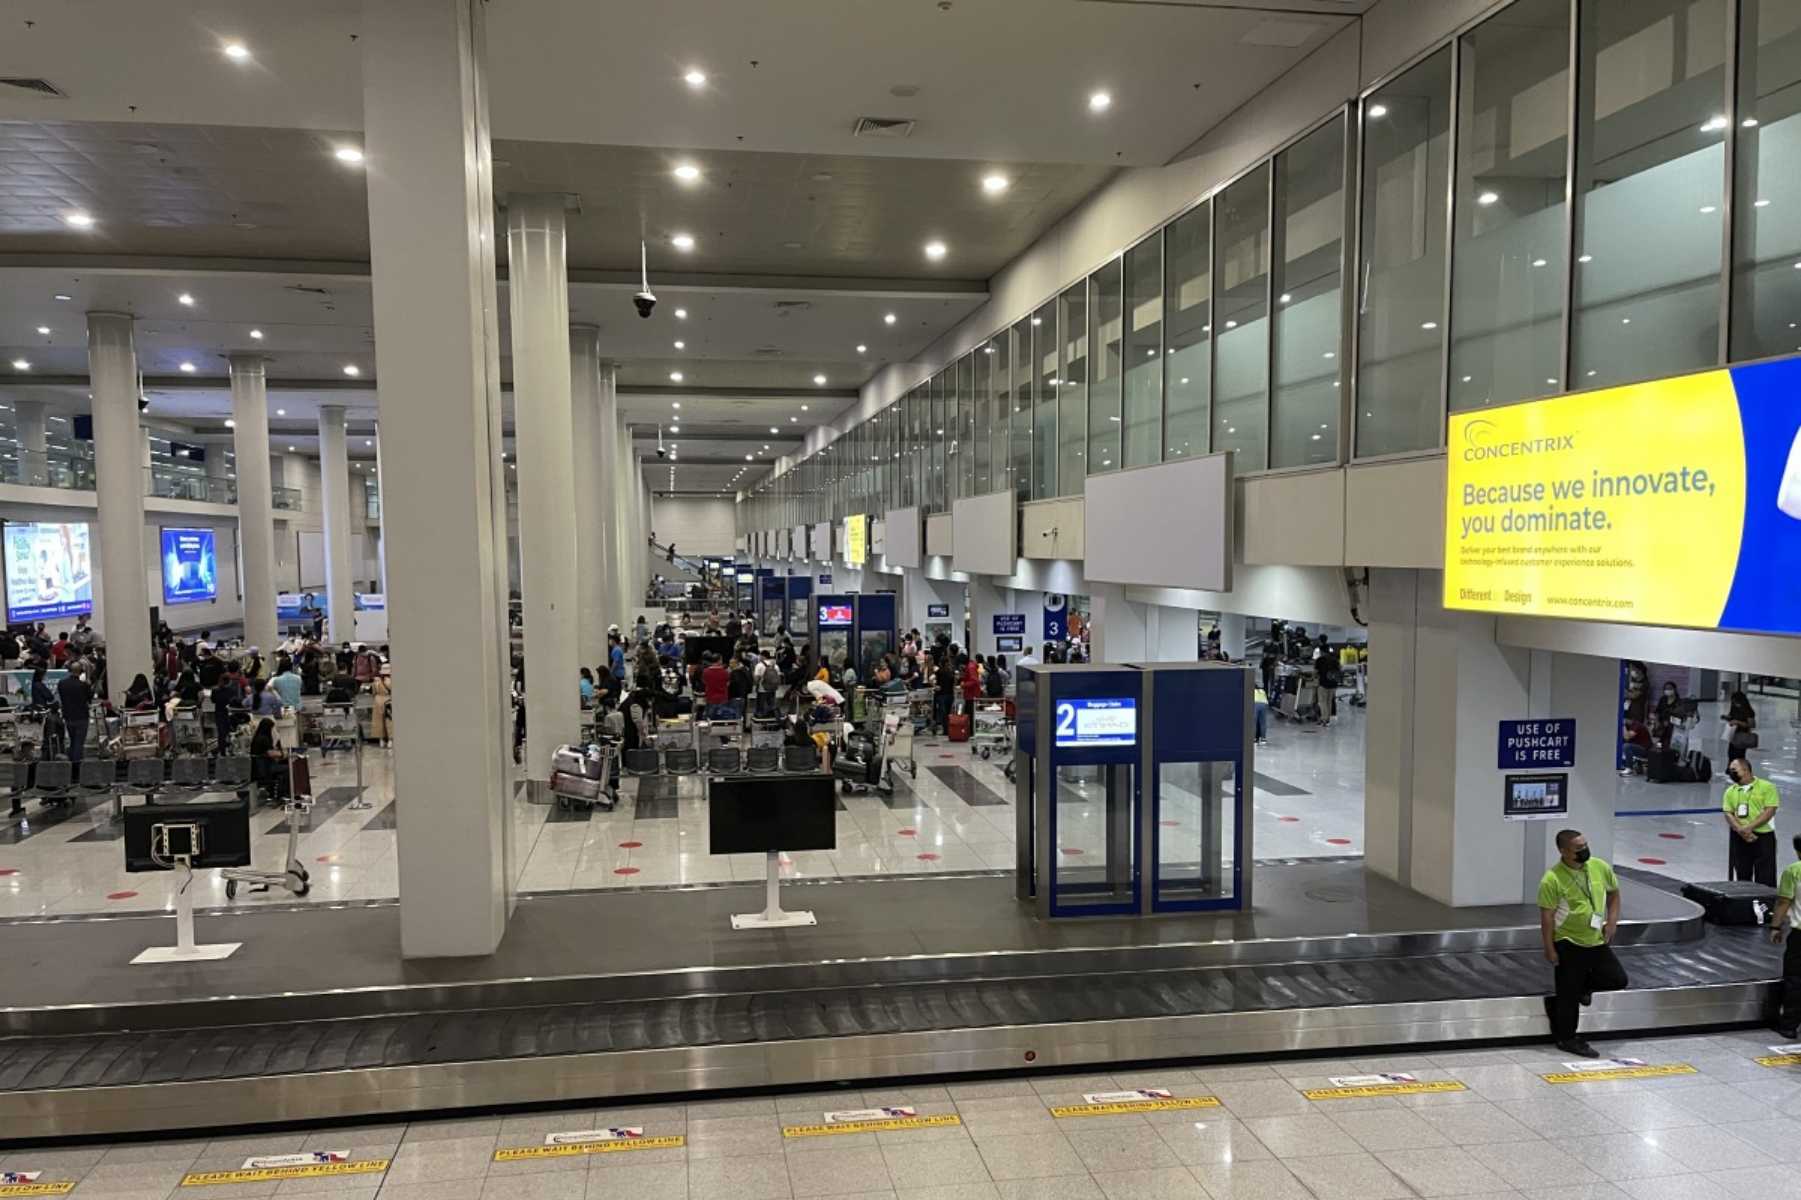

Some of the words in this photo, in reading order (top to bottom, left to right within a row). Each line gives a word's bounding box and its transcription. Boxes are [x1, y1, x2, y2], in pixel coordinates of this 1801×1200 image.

[1463, 435, 1574, 461] CONCENTRIX
[1463, 482, 1545, 506] Because
[1552, 479, 1584, 500] we
[1592, 466, 1716, 498] innovate,
[1461, 514, 1495, 539] you
[1501, 505, 1612, 532] dominate.
[1570, 545, 1587, 554] with
[1589, 546, 1602, 554] our
[1460, 588, 1492, 601] Different
[1504, 590, 1532, 606] Design
[820, 606, 828, 620] 3
[1049, 621, 1059, 635] 3
[1056, 703, 1075, 736] 2
[1516, 724, 1539, 735] USE
[1545, 723, 1561, 734] OF
[1507, 736, 1569, 748] PUSHCART
[1515, 750, 1527, 761] IS
[1533, 749, 1561, 760] FREE
[499, 1148, 539, 1156] PLEASE
[571, 1142, 610, 1150] BEHIND
[613, 1139, 655, 1147] YELLOW
[189, 1173, 233, 1181] PLEASE
[235, 1170, 263, 1178] WAIT
[266, 1167, 307, 1175] BEHIND
[312, 1163, 357, 1171] YELLOW
[359, 1160, 385, 1168] LINE
[0, 1184, 41, 1193] ELLOW
